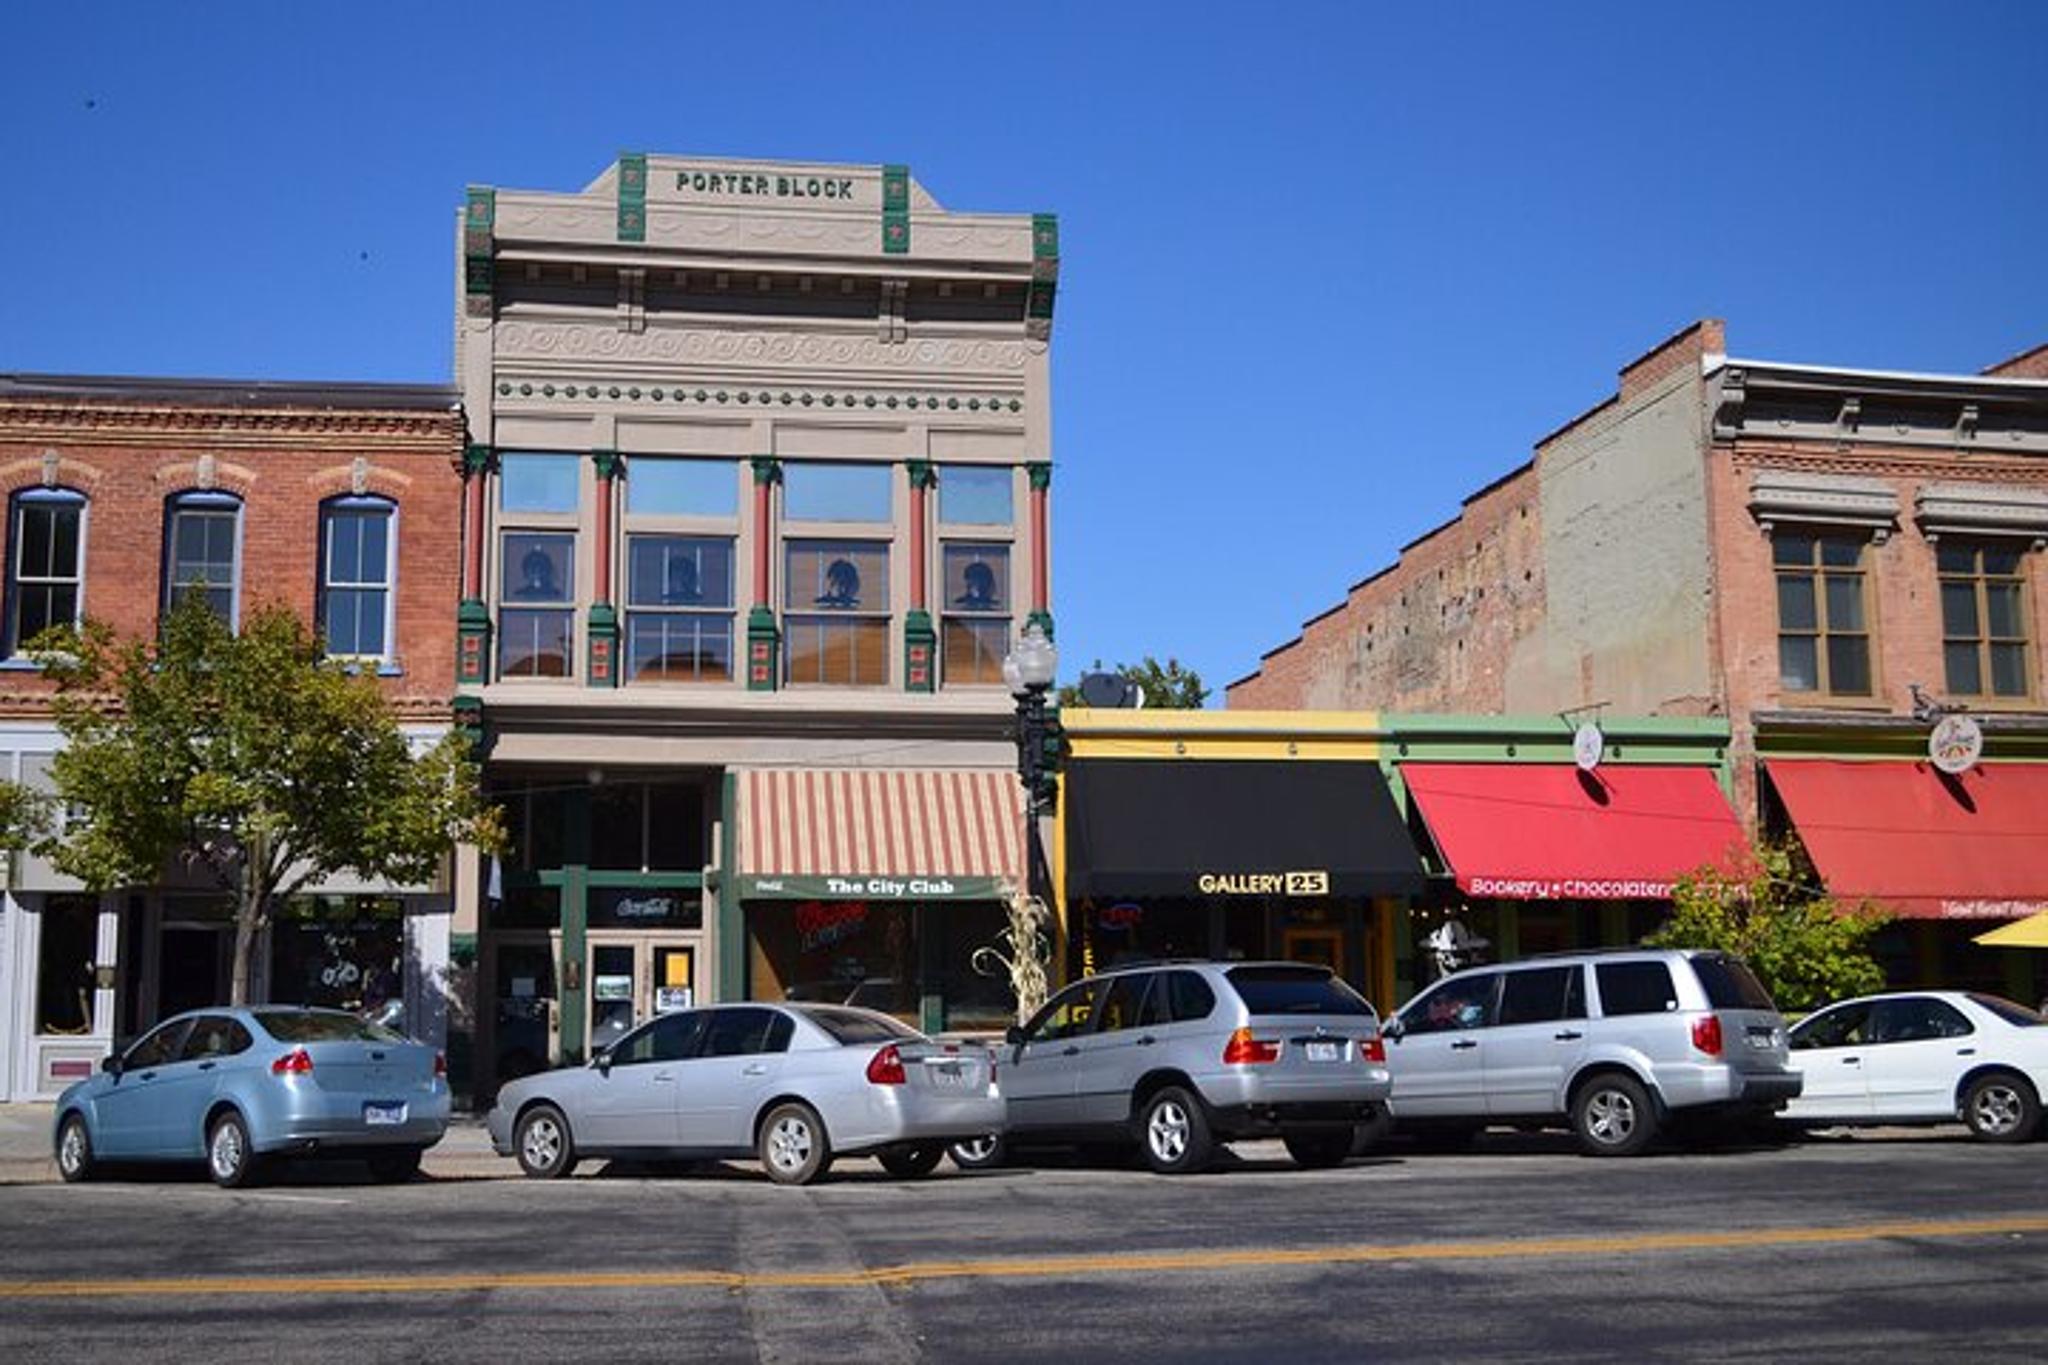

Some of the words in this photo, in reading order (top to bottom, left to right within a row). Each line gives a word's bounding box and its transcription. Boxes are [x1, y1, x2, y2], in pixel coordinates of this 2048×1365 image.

[676, 172, 769, 196] PORTER
[776, 178, 854, 200] BLOCK
[827, 878, 863, 894] The
[867, 880, 905, 897] City
[909, 880, 955, 895] Club
[1199, 874, 1283, 894] GALLERY
[1288, 874, 1325, 892] 25
